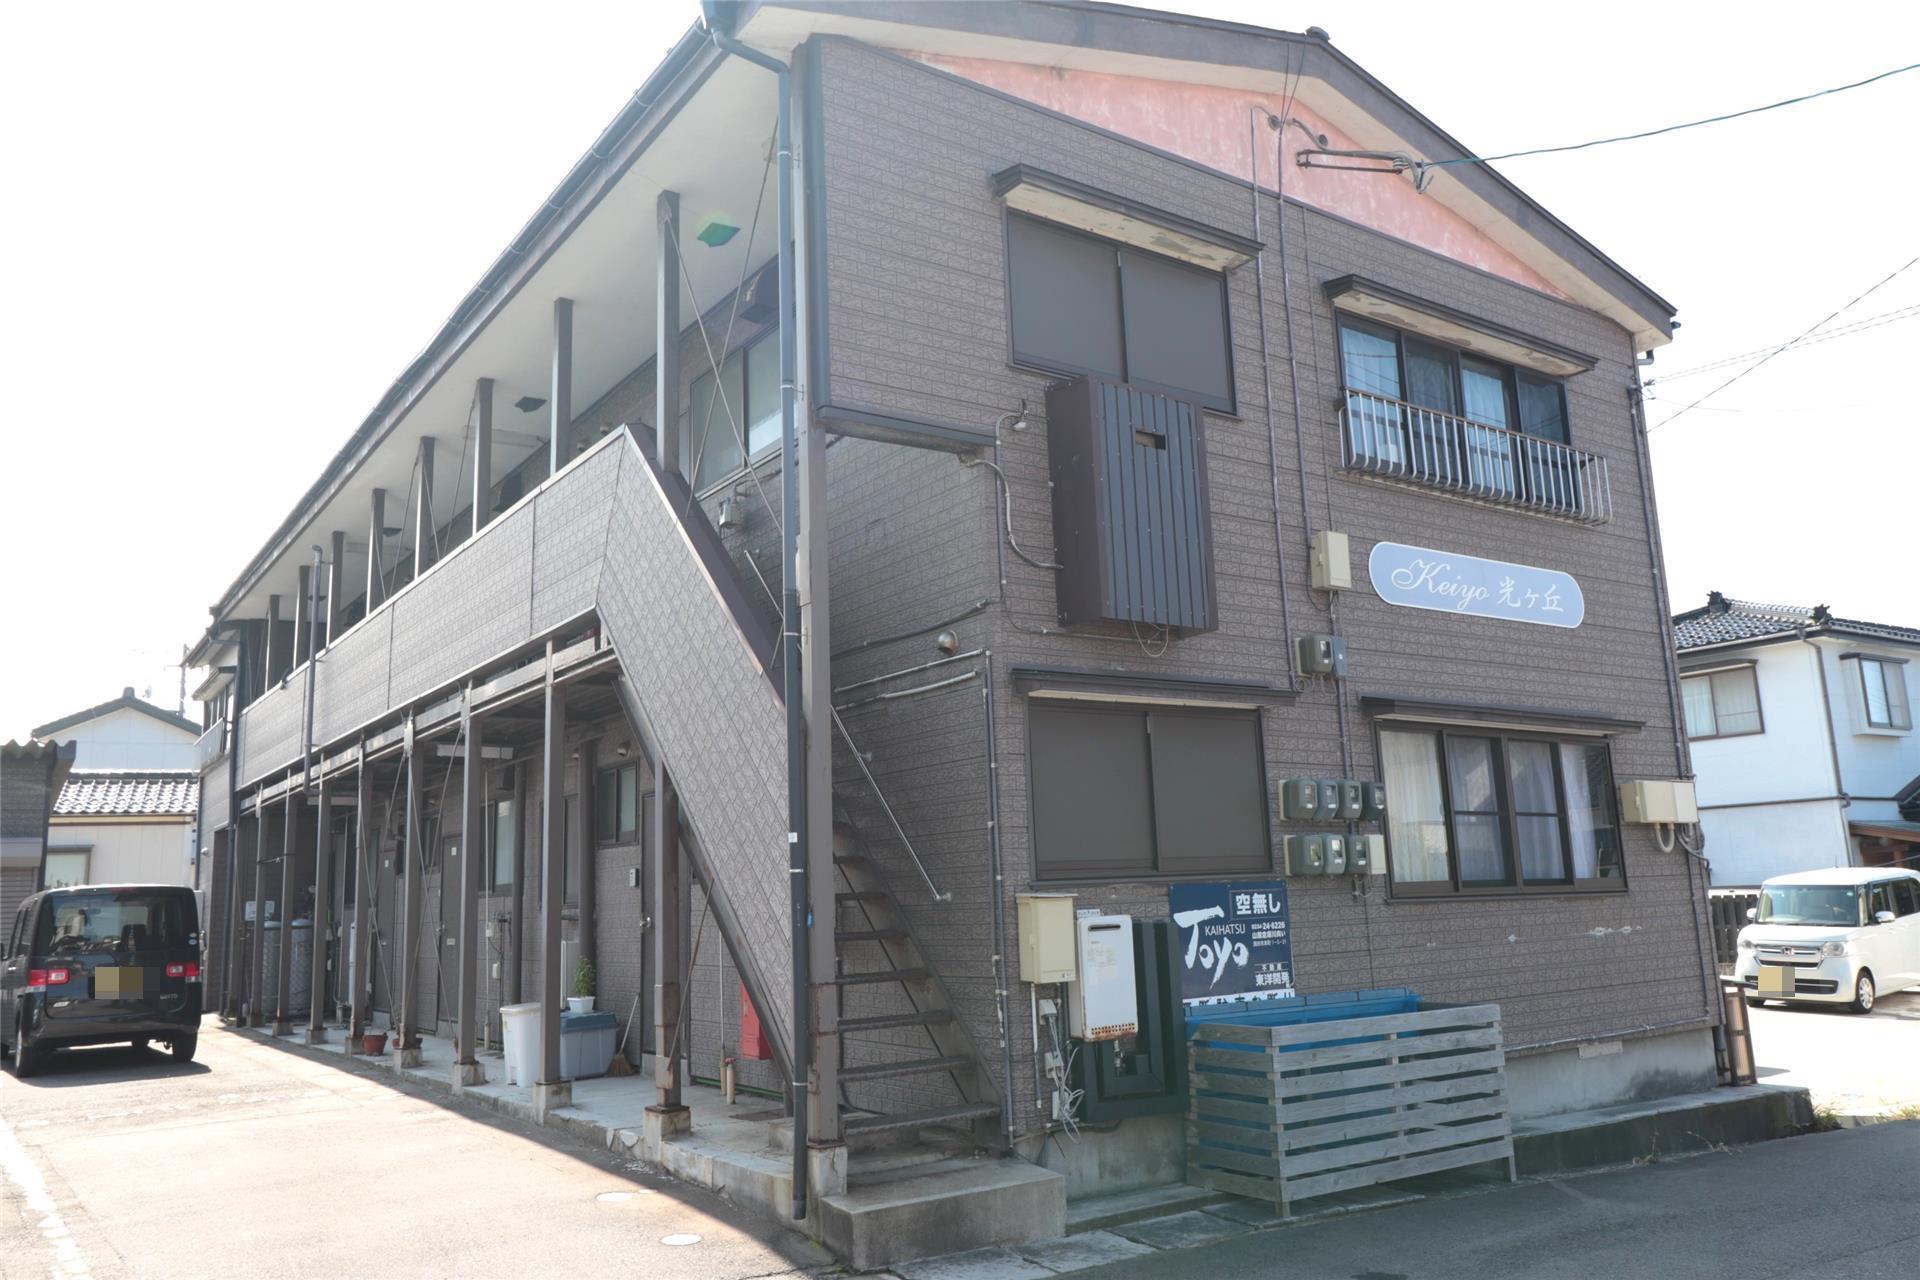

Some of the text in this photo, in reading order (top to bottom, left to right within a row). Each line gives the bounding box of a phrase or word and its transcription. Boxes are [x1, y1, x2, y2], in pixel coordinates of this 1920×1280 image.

[1391, 559, 1489, 608] Keiyo
[1235, 892, 1281, 915] 空無し
[1204, 923, 1246, 936] KAIHATSU
[1173, 905, 1250, 991] Toyo
[1255, 972, 1291, 988] 東洋開発
